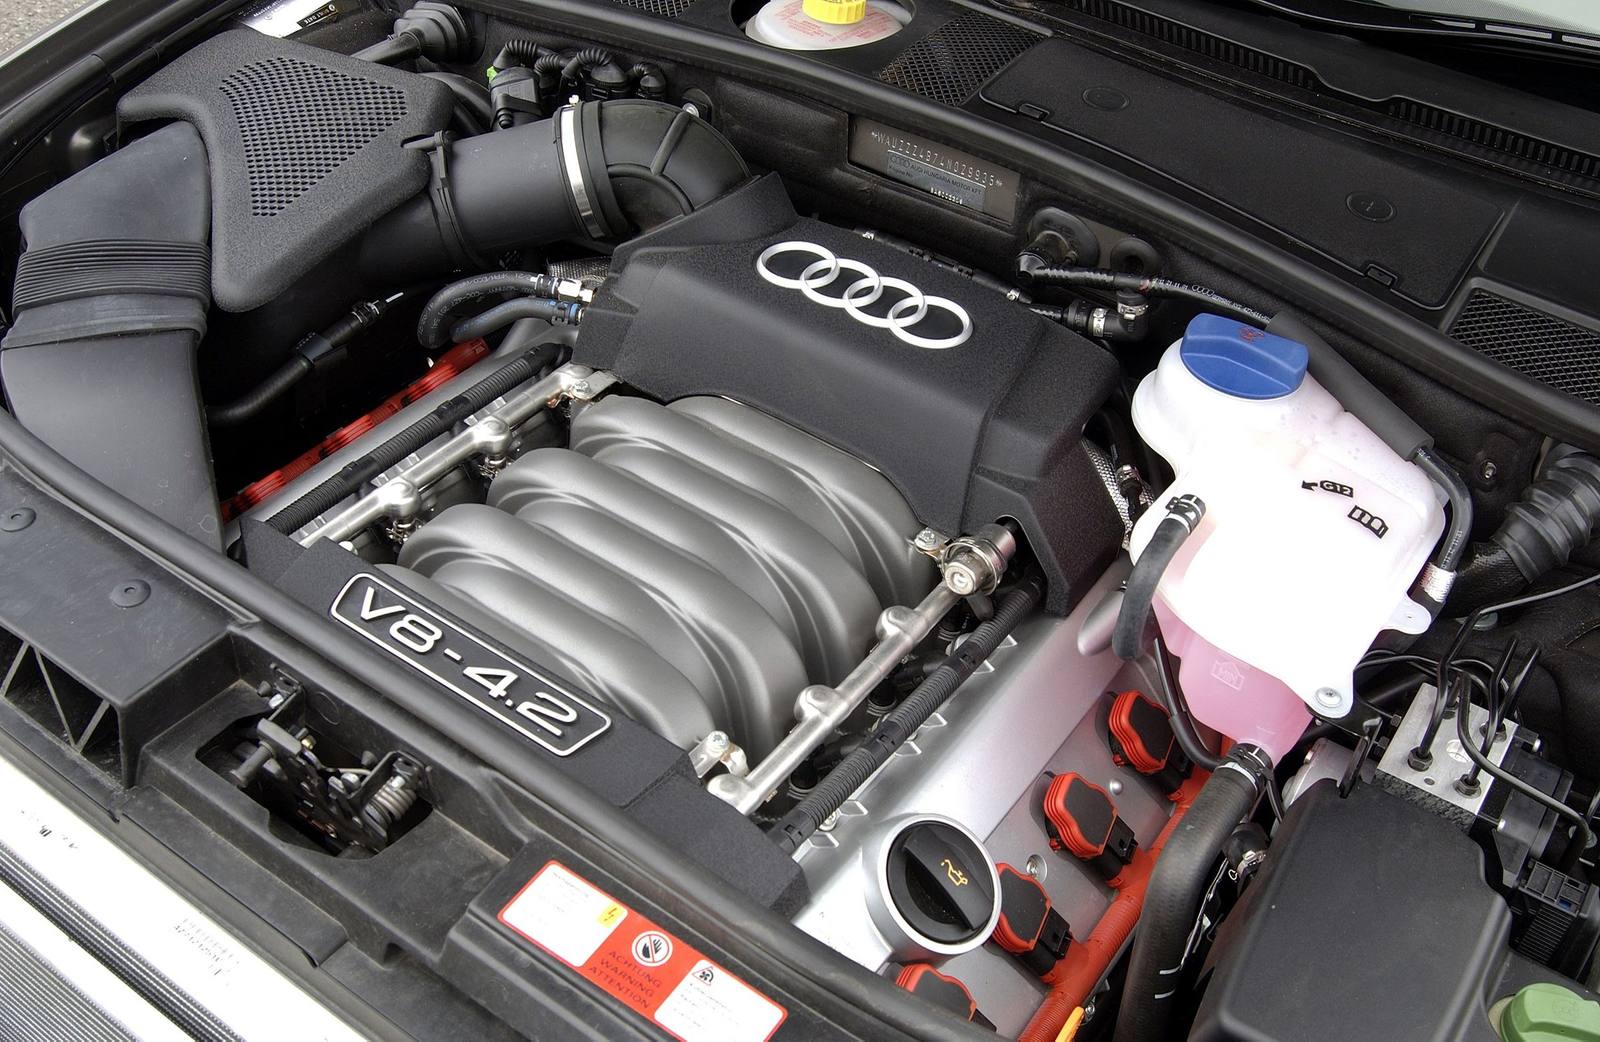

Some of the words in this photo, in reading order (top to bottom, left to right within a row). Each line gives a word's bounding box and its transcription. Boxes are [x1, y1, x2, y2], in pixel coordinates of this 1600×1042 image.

[1322, 481, 1352, 496] G12
[588, 966, 649, 1009] ATTENTION
[600, 958, 654, 998] WARNING
[608, 951, 661, 988] ACHTUNG
